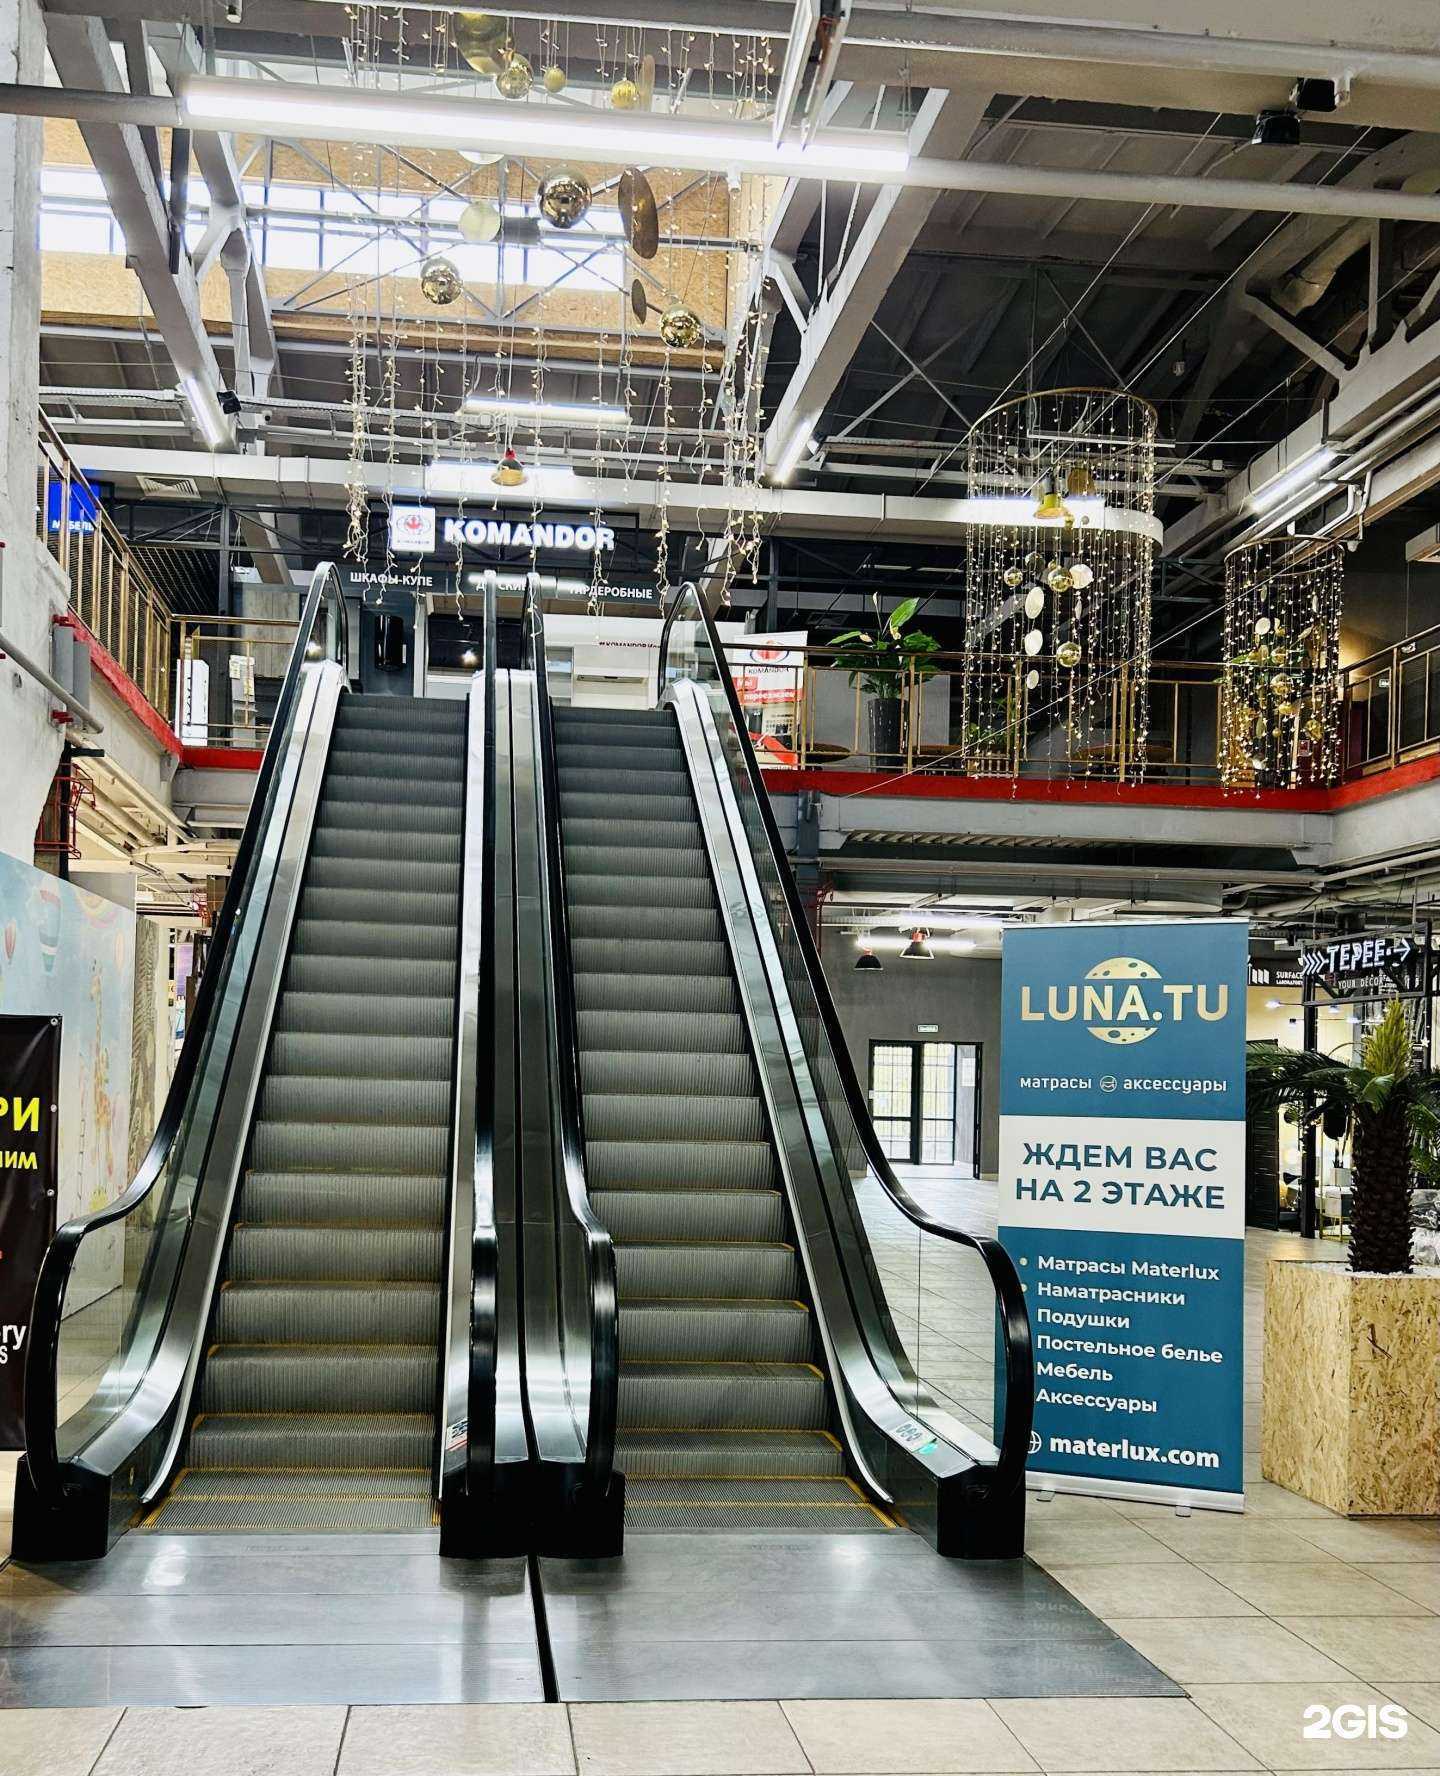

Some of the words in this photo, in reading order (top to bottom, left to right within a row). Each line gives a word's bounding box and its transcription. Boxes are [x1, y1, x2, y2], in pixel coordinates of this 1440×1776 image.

[444, 519, 616, 550] KOMANDOR
[350, 571, 433, 587] ШКАФЫ-КУПЕ
[1327, 938, 1386, 972] TEPEE
[1021, 984, 1229, 1022] LUNA.TU
[1020, 1077, 1092, 1092] матрасы
[1123, 1077, 1228, 1095] аксессуары
[1023, 1143, 1133, 1171] ЖДЕМ
[1146, 1147, 1218, 1172] ВАС
[1016, 1178, 1063, 1203] НА
[1073, 1181, 1092, 1204] 2
[1102, 1182, 1225, 1210] ЭТАЖЕ
[1038, 1256, 1126, 1275] Матрасы
[1131, 1260, 1220, 1281] Materlux
[1037, 1282, 1186, 1306] Наматрасники
[1037, 1308, 1130, 1329] Подушки
[1037, 1335, 1155, 1359] Постельное
[1161, 1344, 1224, 1363] белье
[1036, 1362, 1114, 1382] Мебель
[1036, 1389, 1158, 1414] Аксессуары
[1049, 1435, 1220, 1468] materlux.com
